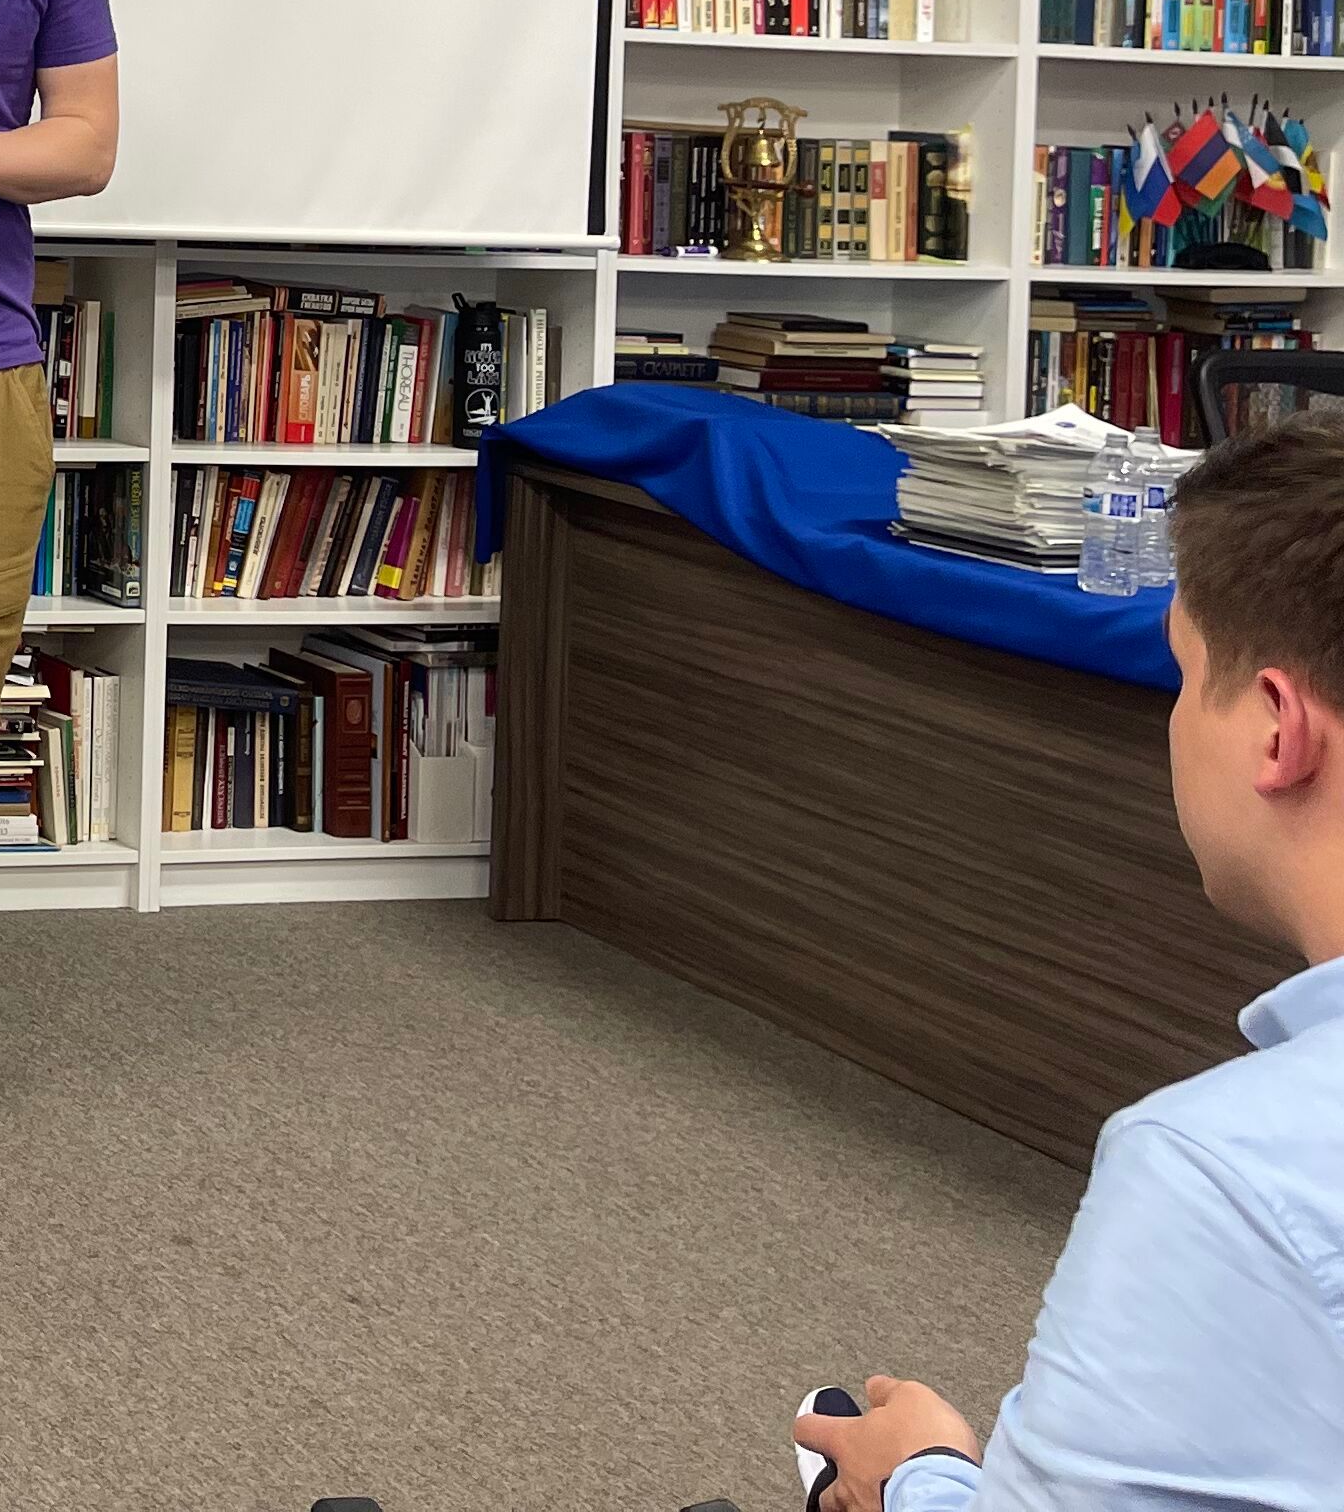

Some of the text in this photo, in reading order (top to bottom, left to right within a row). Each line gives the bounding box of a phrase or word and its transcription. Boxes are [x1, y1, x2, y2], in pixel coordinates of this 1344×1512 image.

[398, 350, 415, 413] THOREAU
[475, 363, 496, 372] TOO
[298, 374, 311, 419] СЛОВАРЬ
